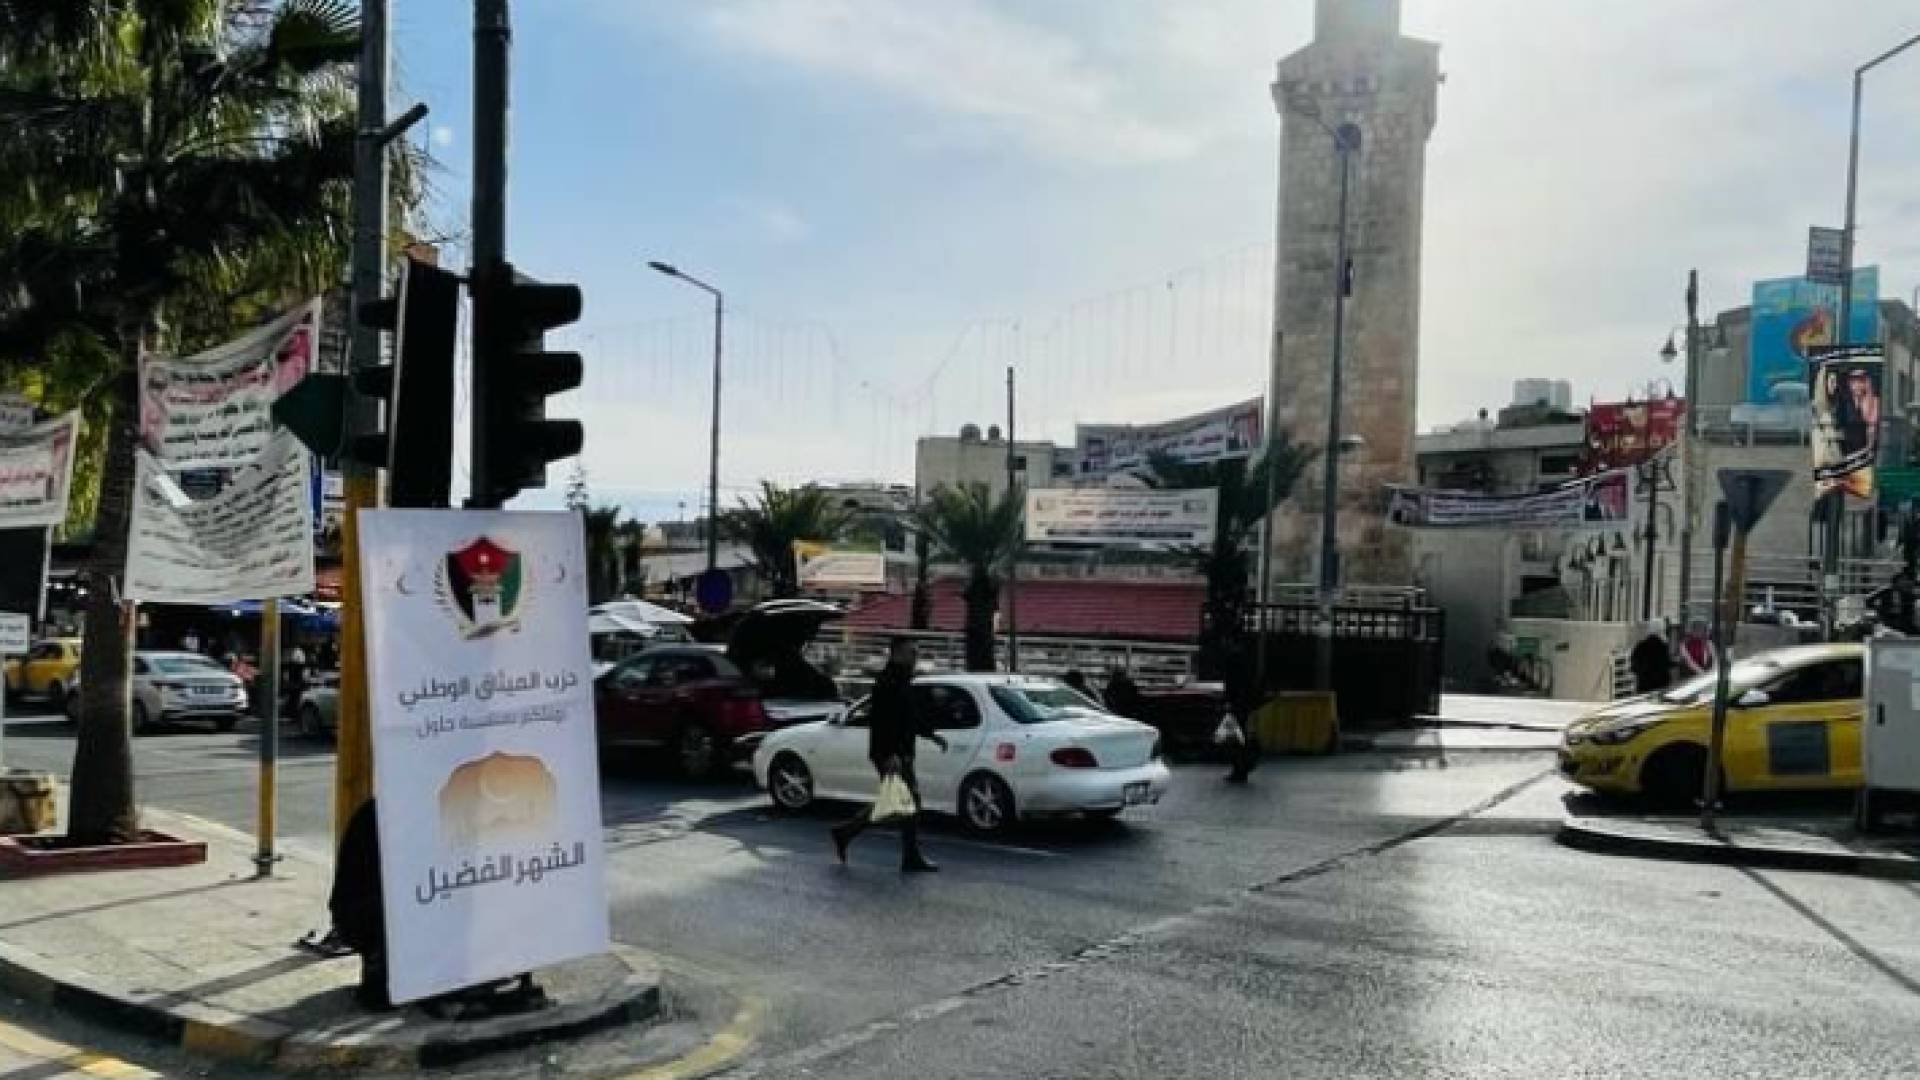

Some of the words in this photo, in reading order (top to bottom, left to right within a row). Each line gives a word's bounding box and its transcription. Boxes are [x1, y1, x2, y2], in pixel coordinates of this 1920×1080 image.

[399, 676, 471, 711] الوطني
[474, 670, 541, 700] الميثاق
[545, 670, 578, 693] حزب
[415, 855, 512, 904] الفضيل
[514, 841, 584, 886] الشهر
